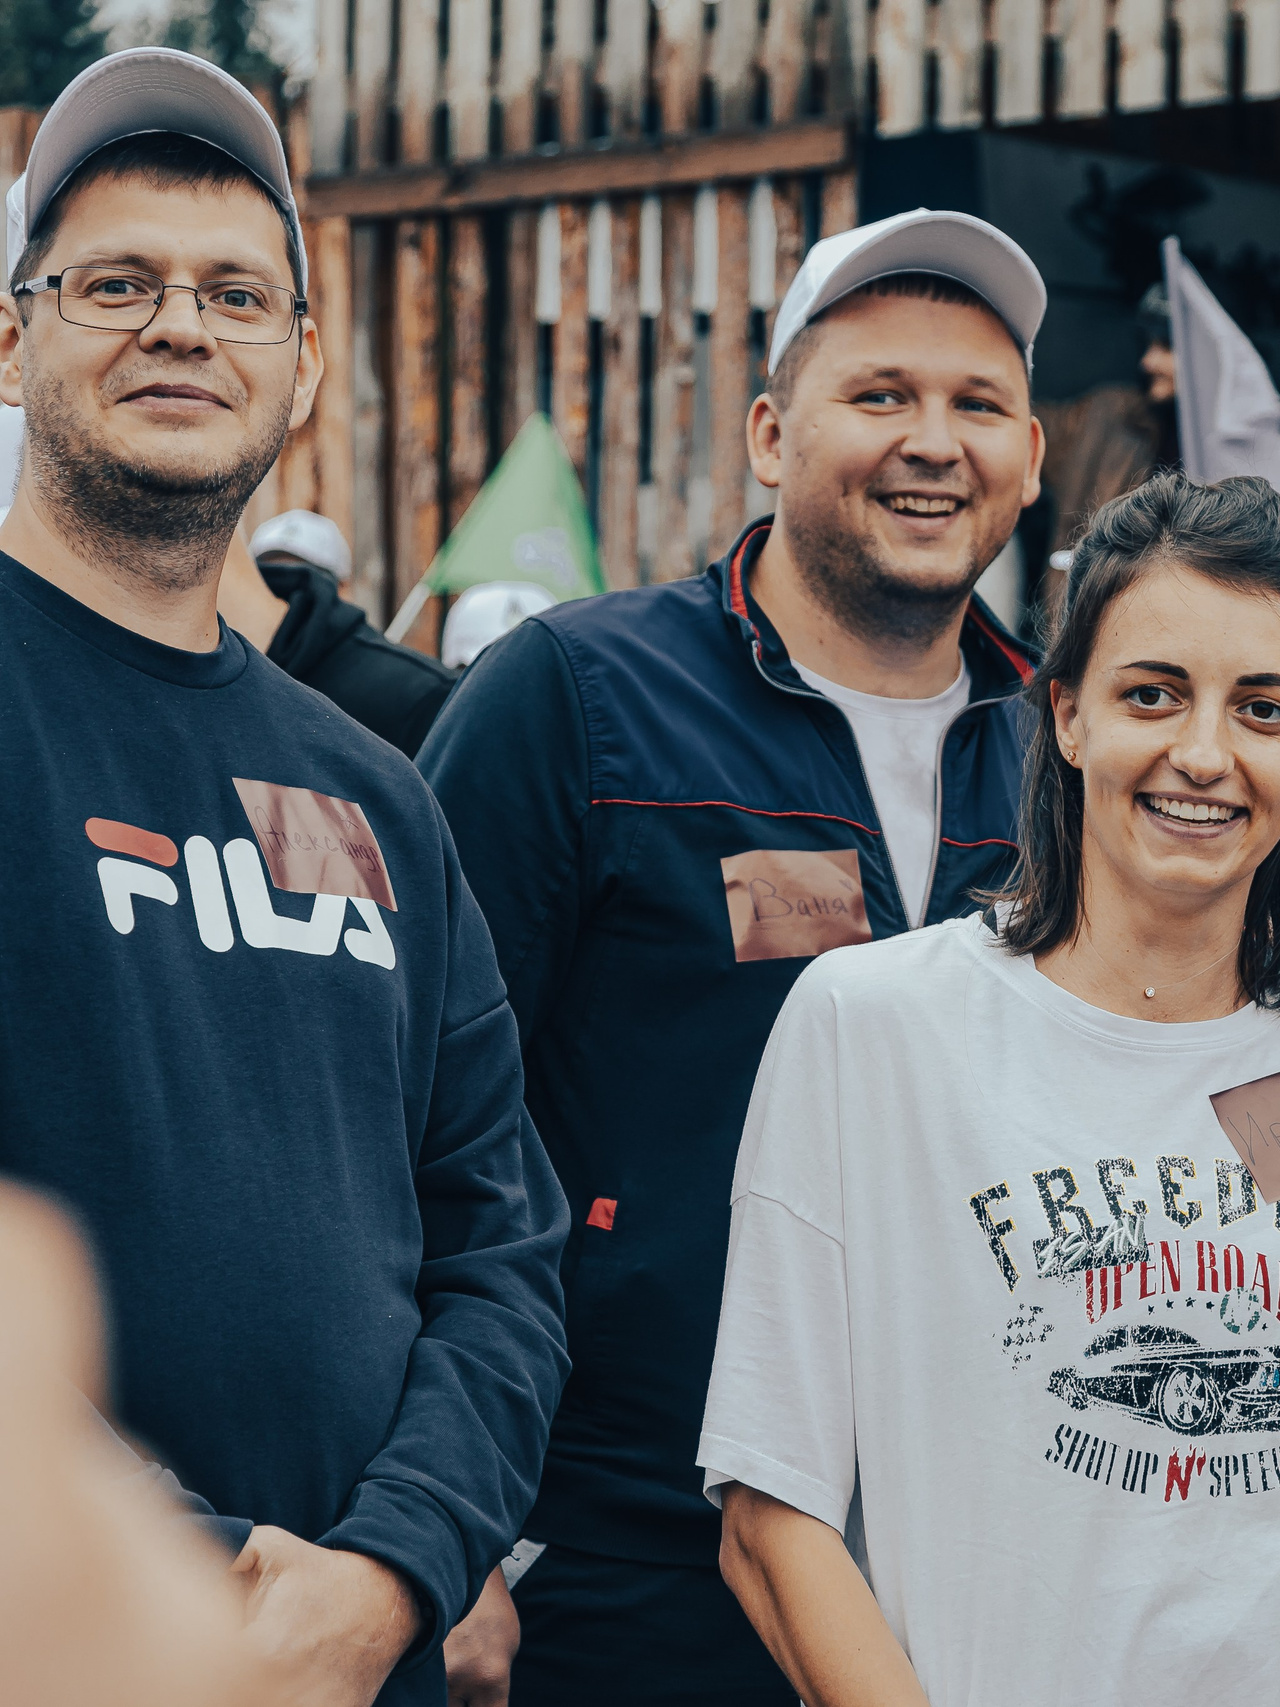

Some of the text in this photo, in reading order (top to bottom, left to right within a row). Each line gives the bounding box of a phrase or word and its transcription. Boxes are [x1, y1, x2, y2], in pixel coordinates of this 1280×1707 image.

[749, 877, 849, 922] Ваня
[1085, 1239, 1181, 1325] OPEN
[1044, 1422, 1122, 1486] SHUT
[1121, 1448, 1160, 1495] UP
